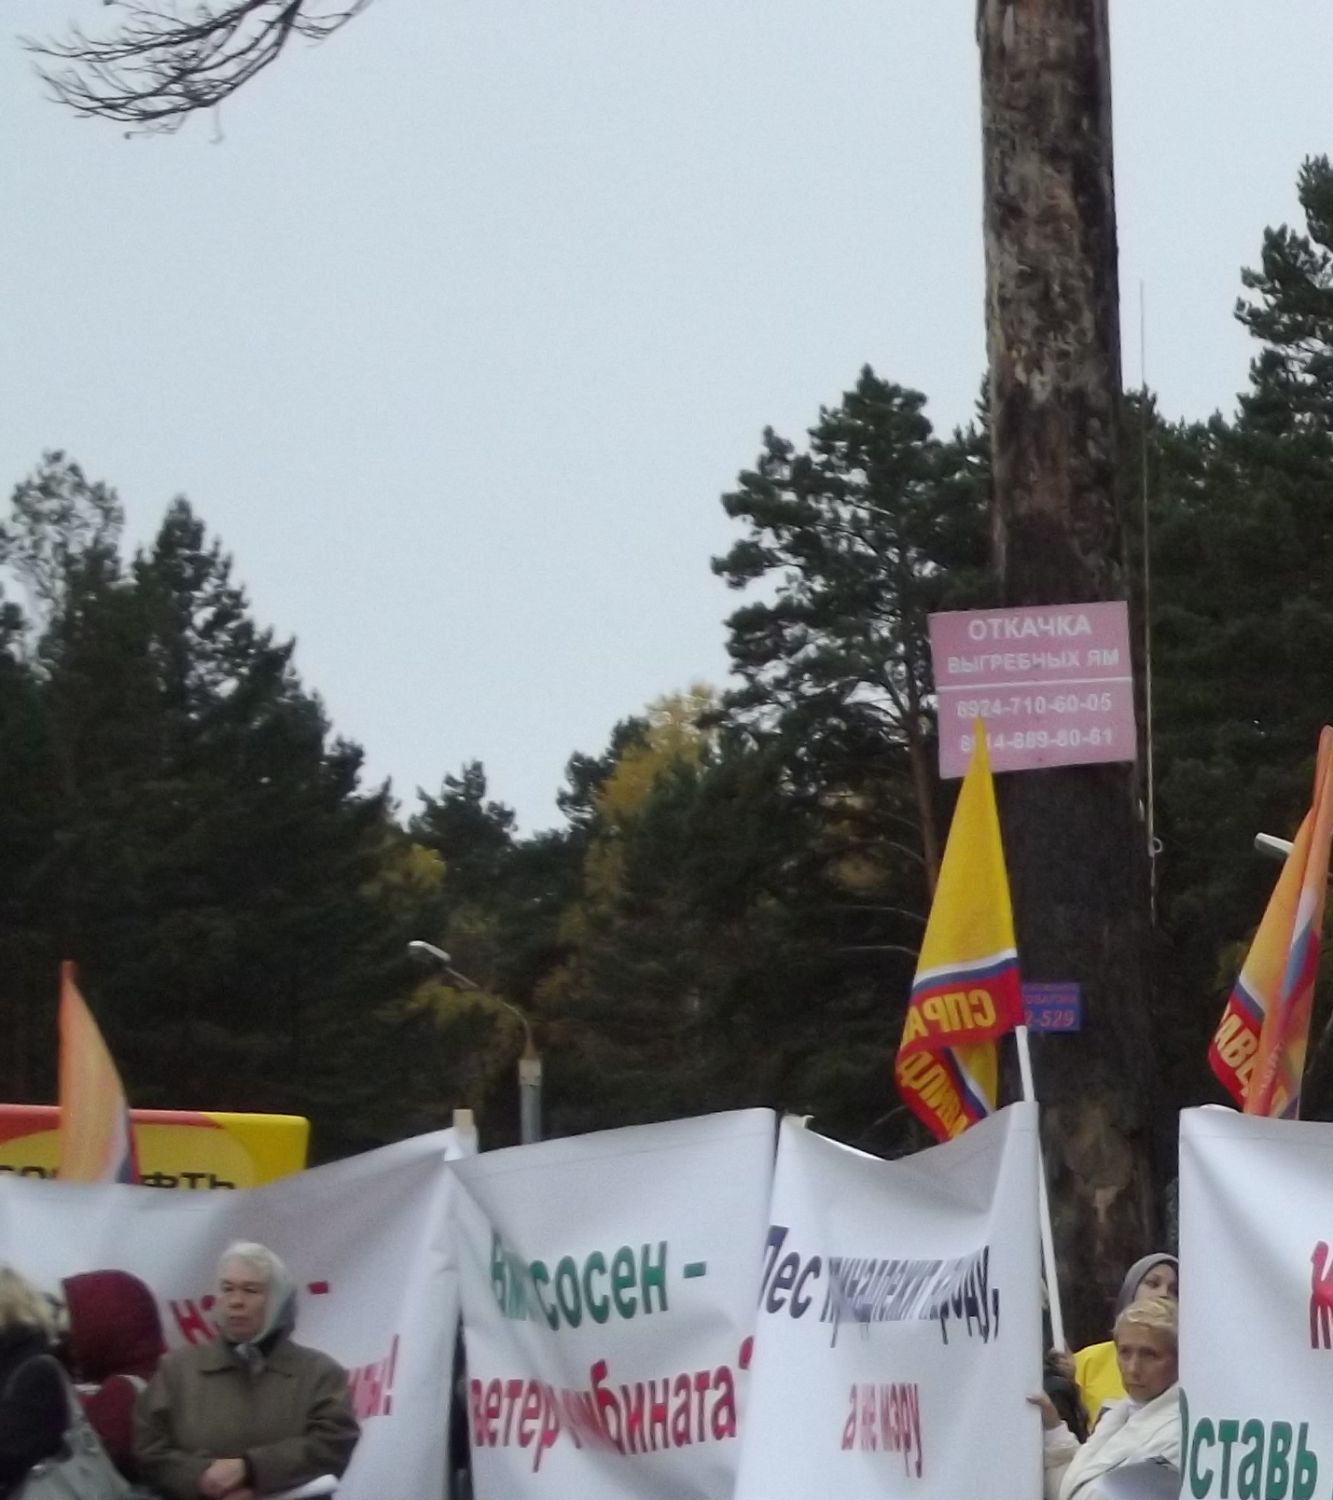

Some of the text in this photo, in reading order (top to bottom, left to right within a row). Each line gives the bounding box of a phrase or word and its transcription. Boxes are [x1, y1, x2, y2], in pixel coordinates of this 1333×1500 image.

[968, 614, 1093, 640] ОТКАЧКА
[947, 648, 1121, 674] ВЫГРЕБНЫХ ЯМ
